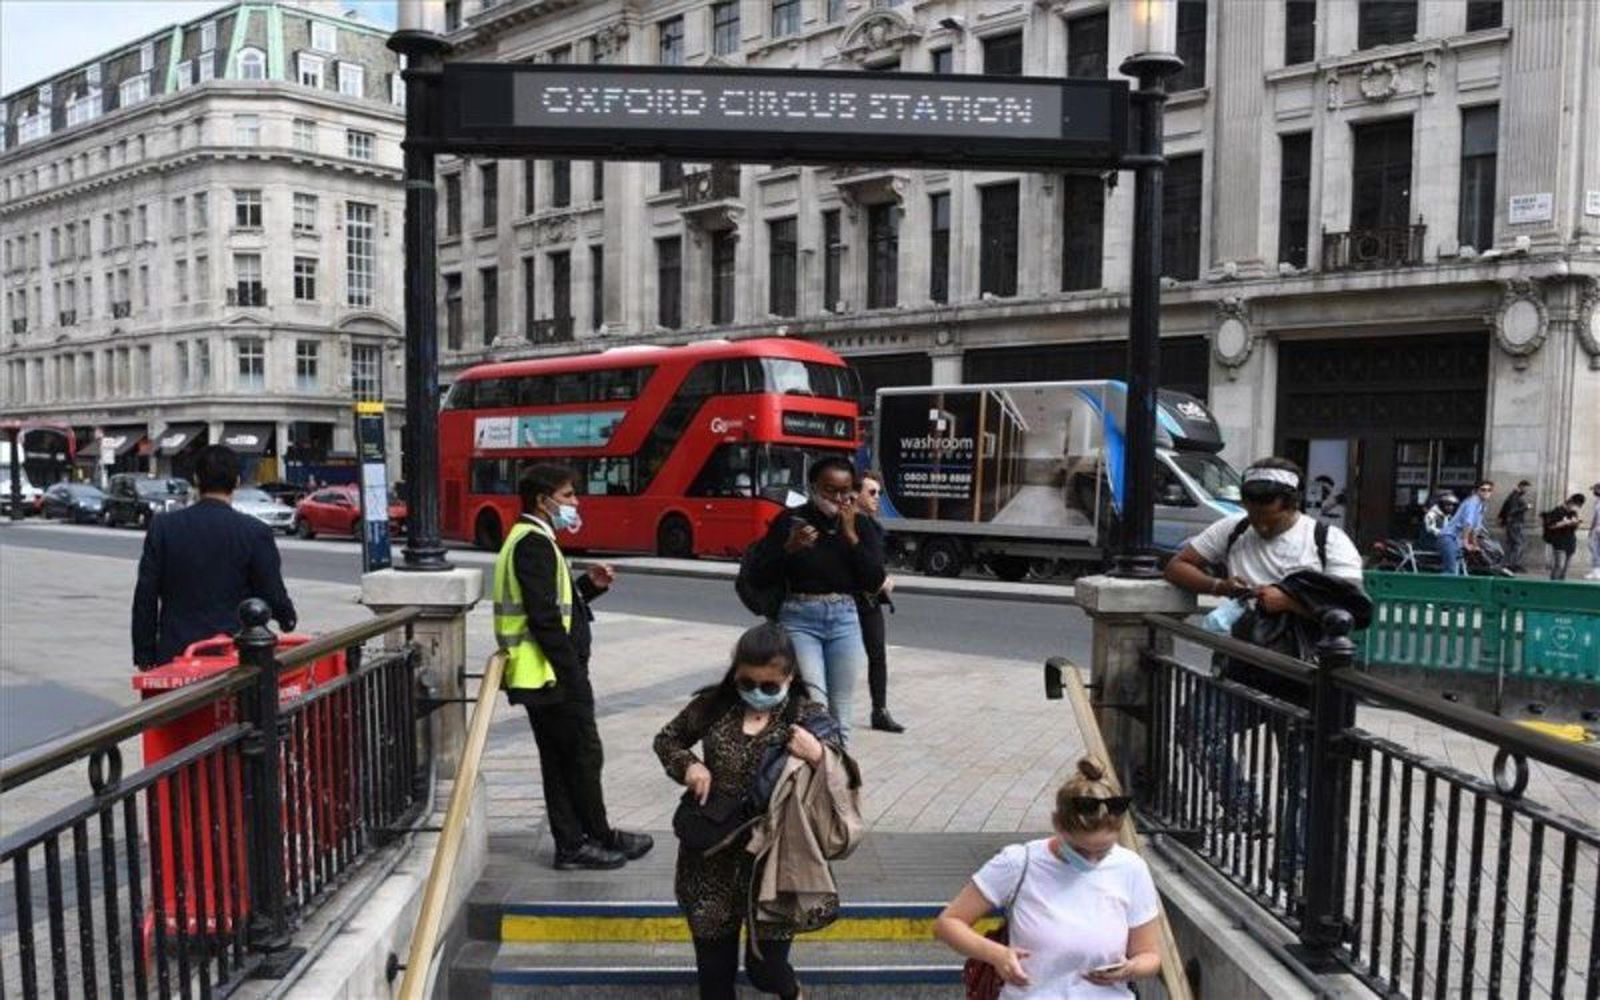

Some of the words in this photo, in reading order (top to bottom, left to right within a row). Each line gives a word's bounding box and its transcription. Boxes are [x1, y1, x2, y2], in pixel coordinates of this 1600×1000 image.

[543, 86, 707, 115] OXFORD
[719, 90, 857, 119] CIRCUS
[869, 93, 1032, 123] STATION
[900, 433, 974, 450] washroom
[903, 472, 929, 482] 0800
[143, 677, 169, 689] FREE
